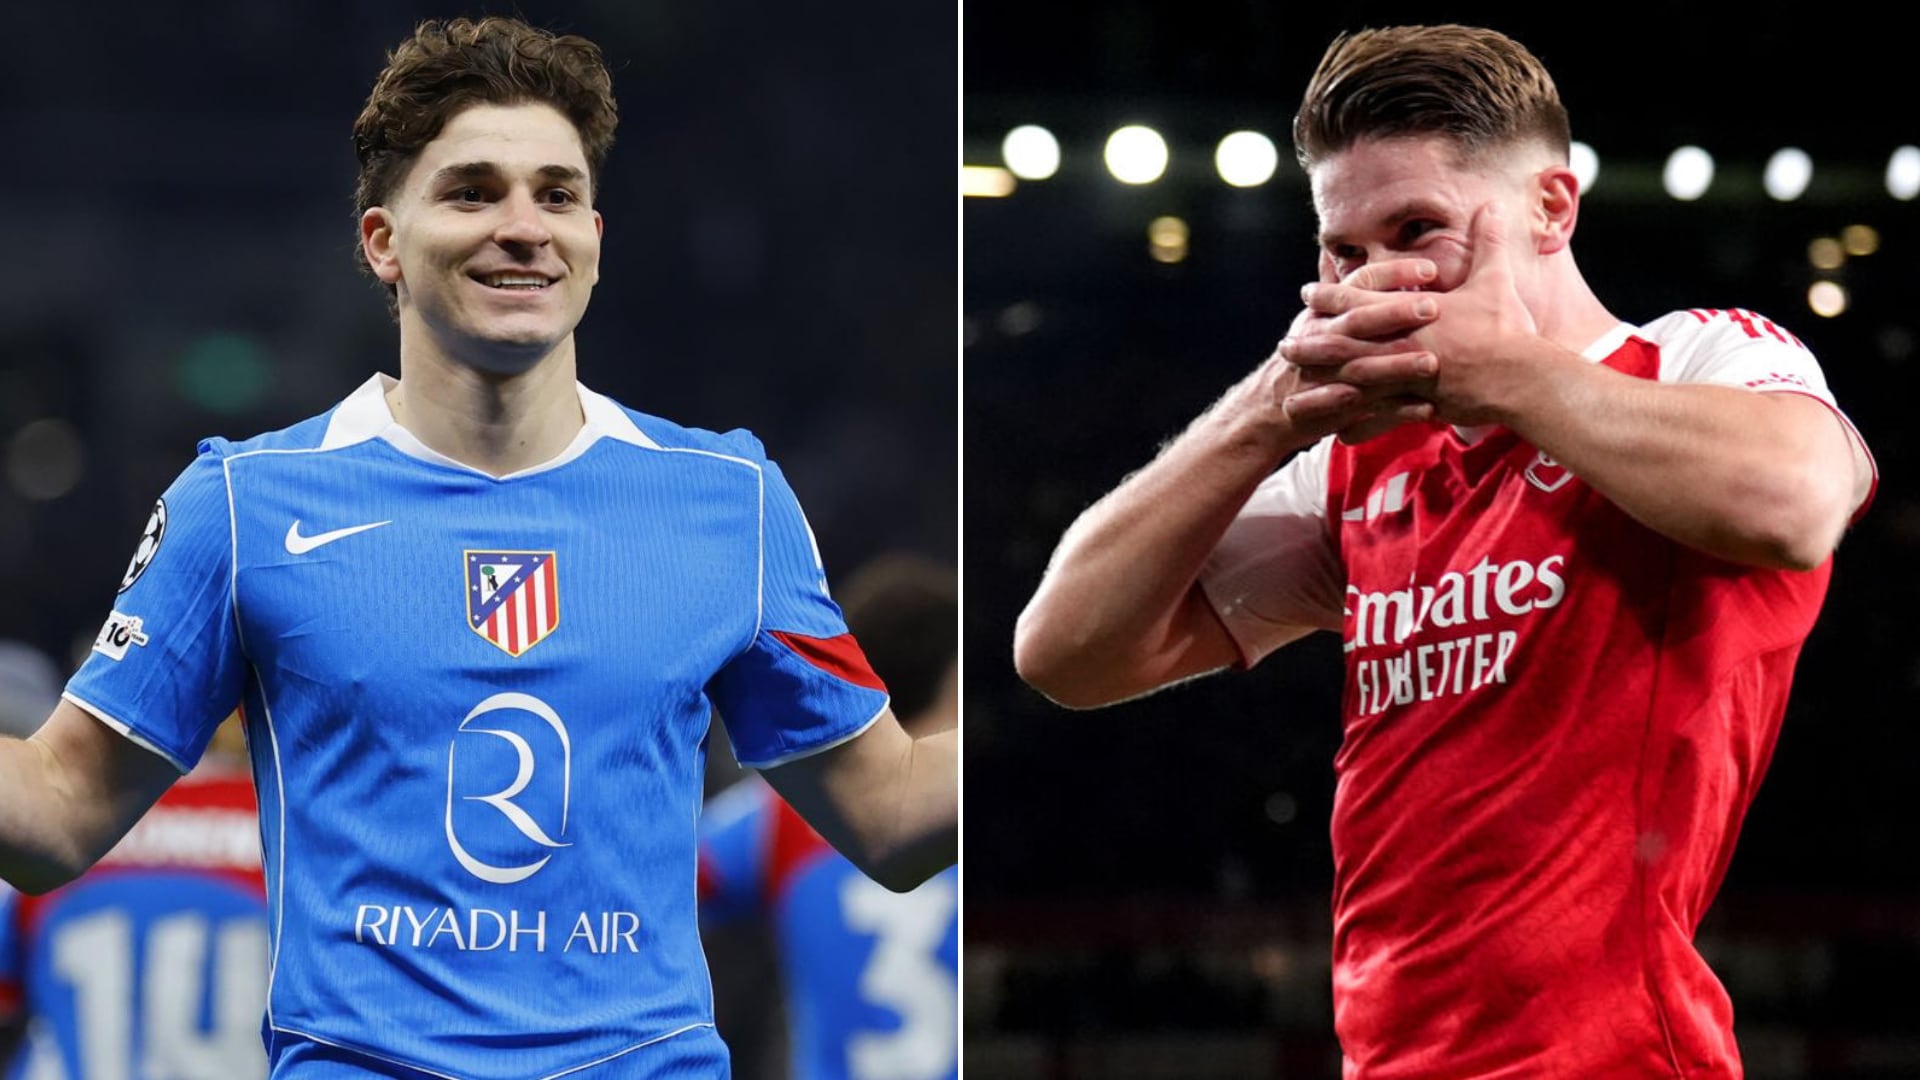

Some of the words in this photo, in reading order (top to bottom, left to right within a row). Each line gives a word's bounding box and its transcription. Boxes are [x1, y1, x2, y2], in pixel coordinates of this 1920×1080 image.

[1357, 631, 1517, 716] FLYBETTER
[355, 904, 546, 952] RIYADH
[563, 911, 640, 953] AIR
[53, 905, 271, 1080] 14
